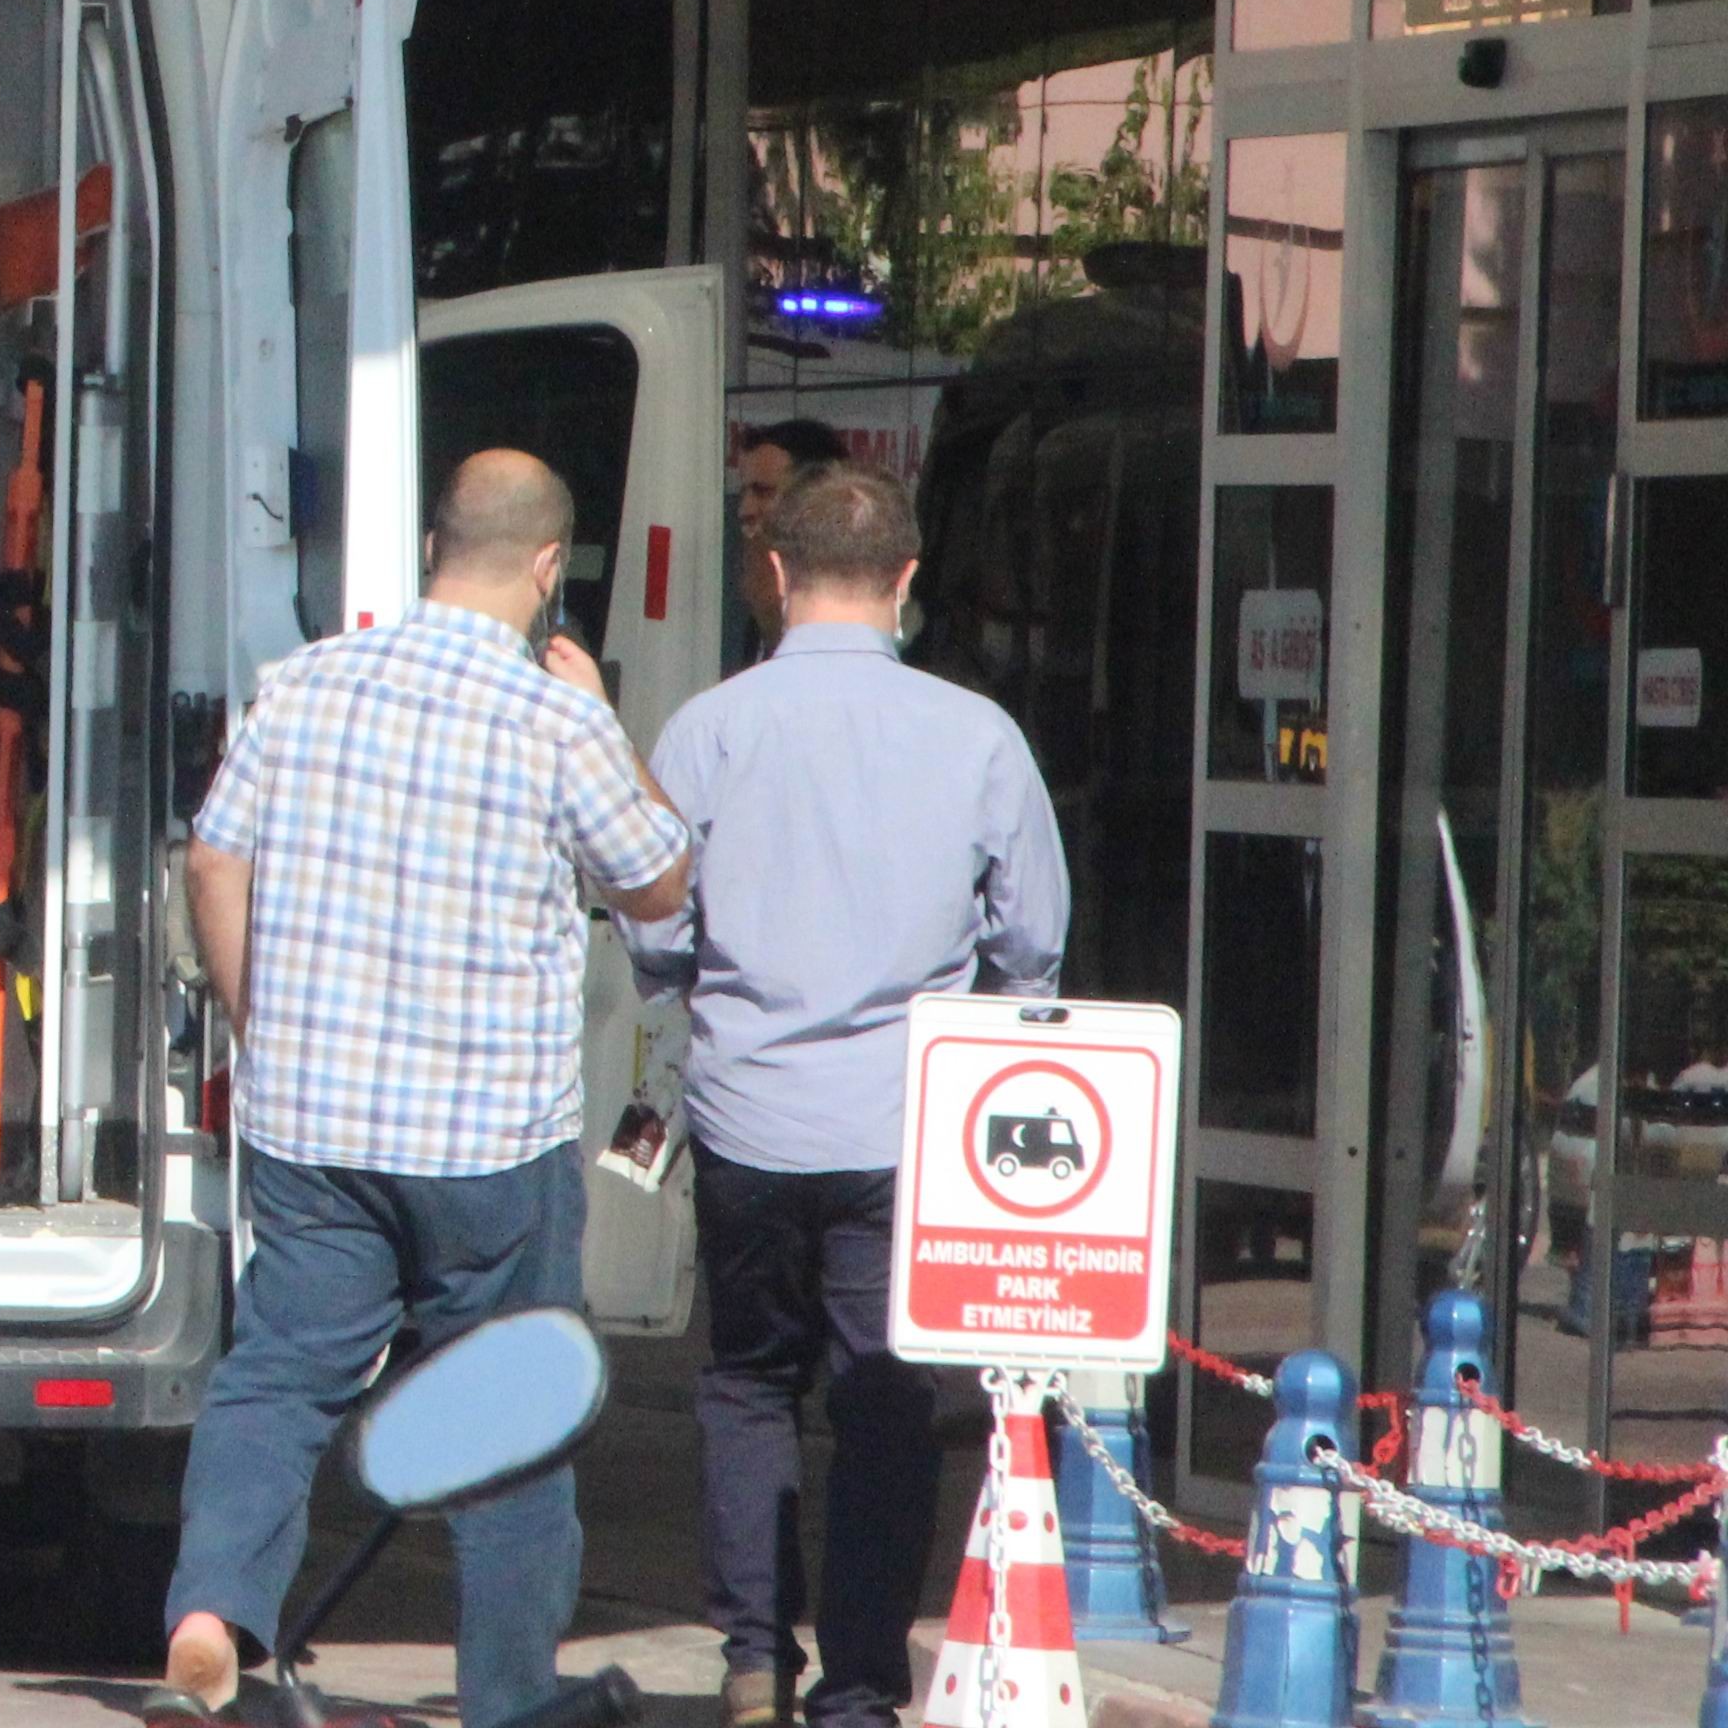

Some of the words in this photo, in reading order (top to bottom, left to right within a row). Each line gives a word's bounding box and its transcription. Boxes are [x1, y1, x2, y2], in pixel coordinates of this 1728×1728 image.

[916, 1238, 1048, 1270] AMBULANS
[1054, 1240, 1145, 1276] İÇİNDİR
[996, 1273, 1061, 1302] PARK
[961, 1303, 1094, 1334] ETMEYİNİZ
